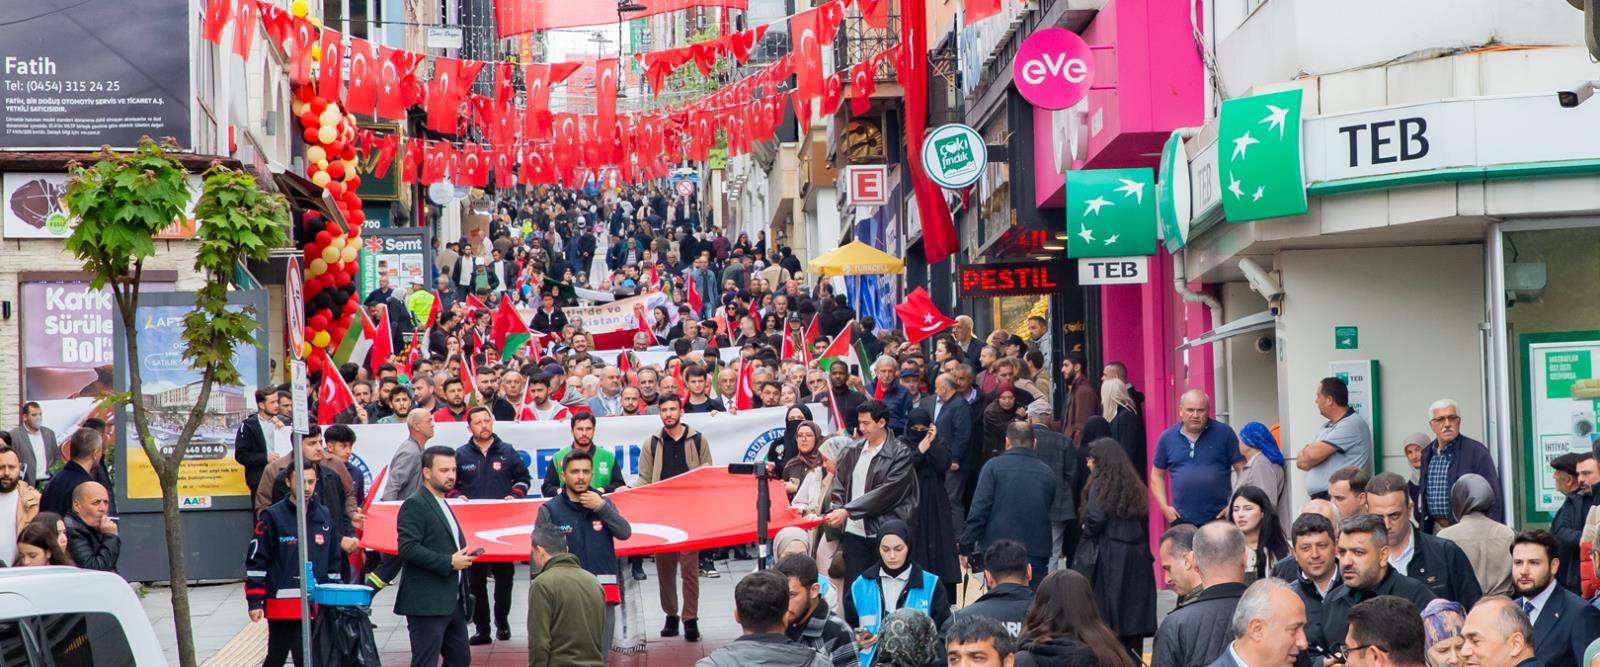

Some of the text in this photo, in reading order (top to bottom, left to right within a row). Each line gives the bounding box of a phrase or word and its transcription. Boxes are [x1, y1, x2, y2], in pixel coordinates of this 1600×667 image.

[5, 57, 56, 75] Fatih
[1022, 53, 1088, 85] eve
[5, 81, 120, 93] Tel: (0454) 315 24 25
[61, 97, 95, 105] OTOMOTİV
[1339, 117, 1430, 168] TEB
[857, 173, 878, 197] E
[1197, 162, 1212, 206] TEB
[385, 239, 422, 251] Semt
[1088, 261, 1138, 279] TEB
[62, 337, 103, 363] Bol
[213, 445, 225, 453] 40
